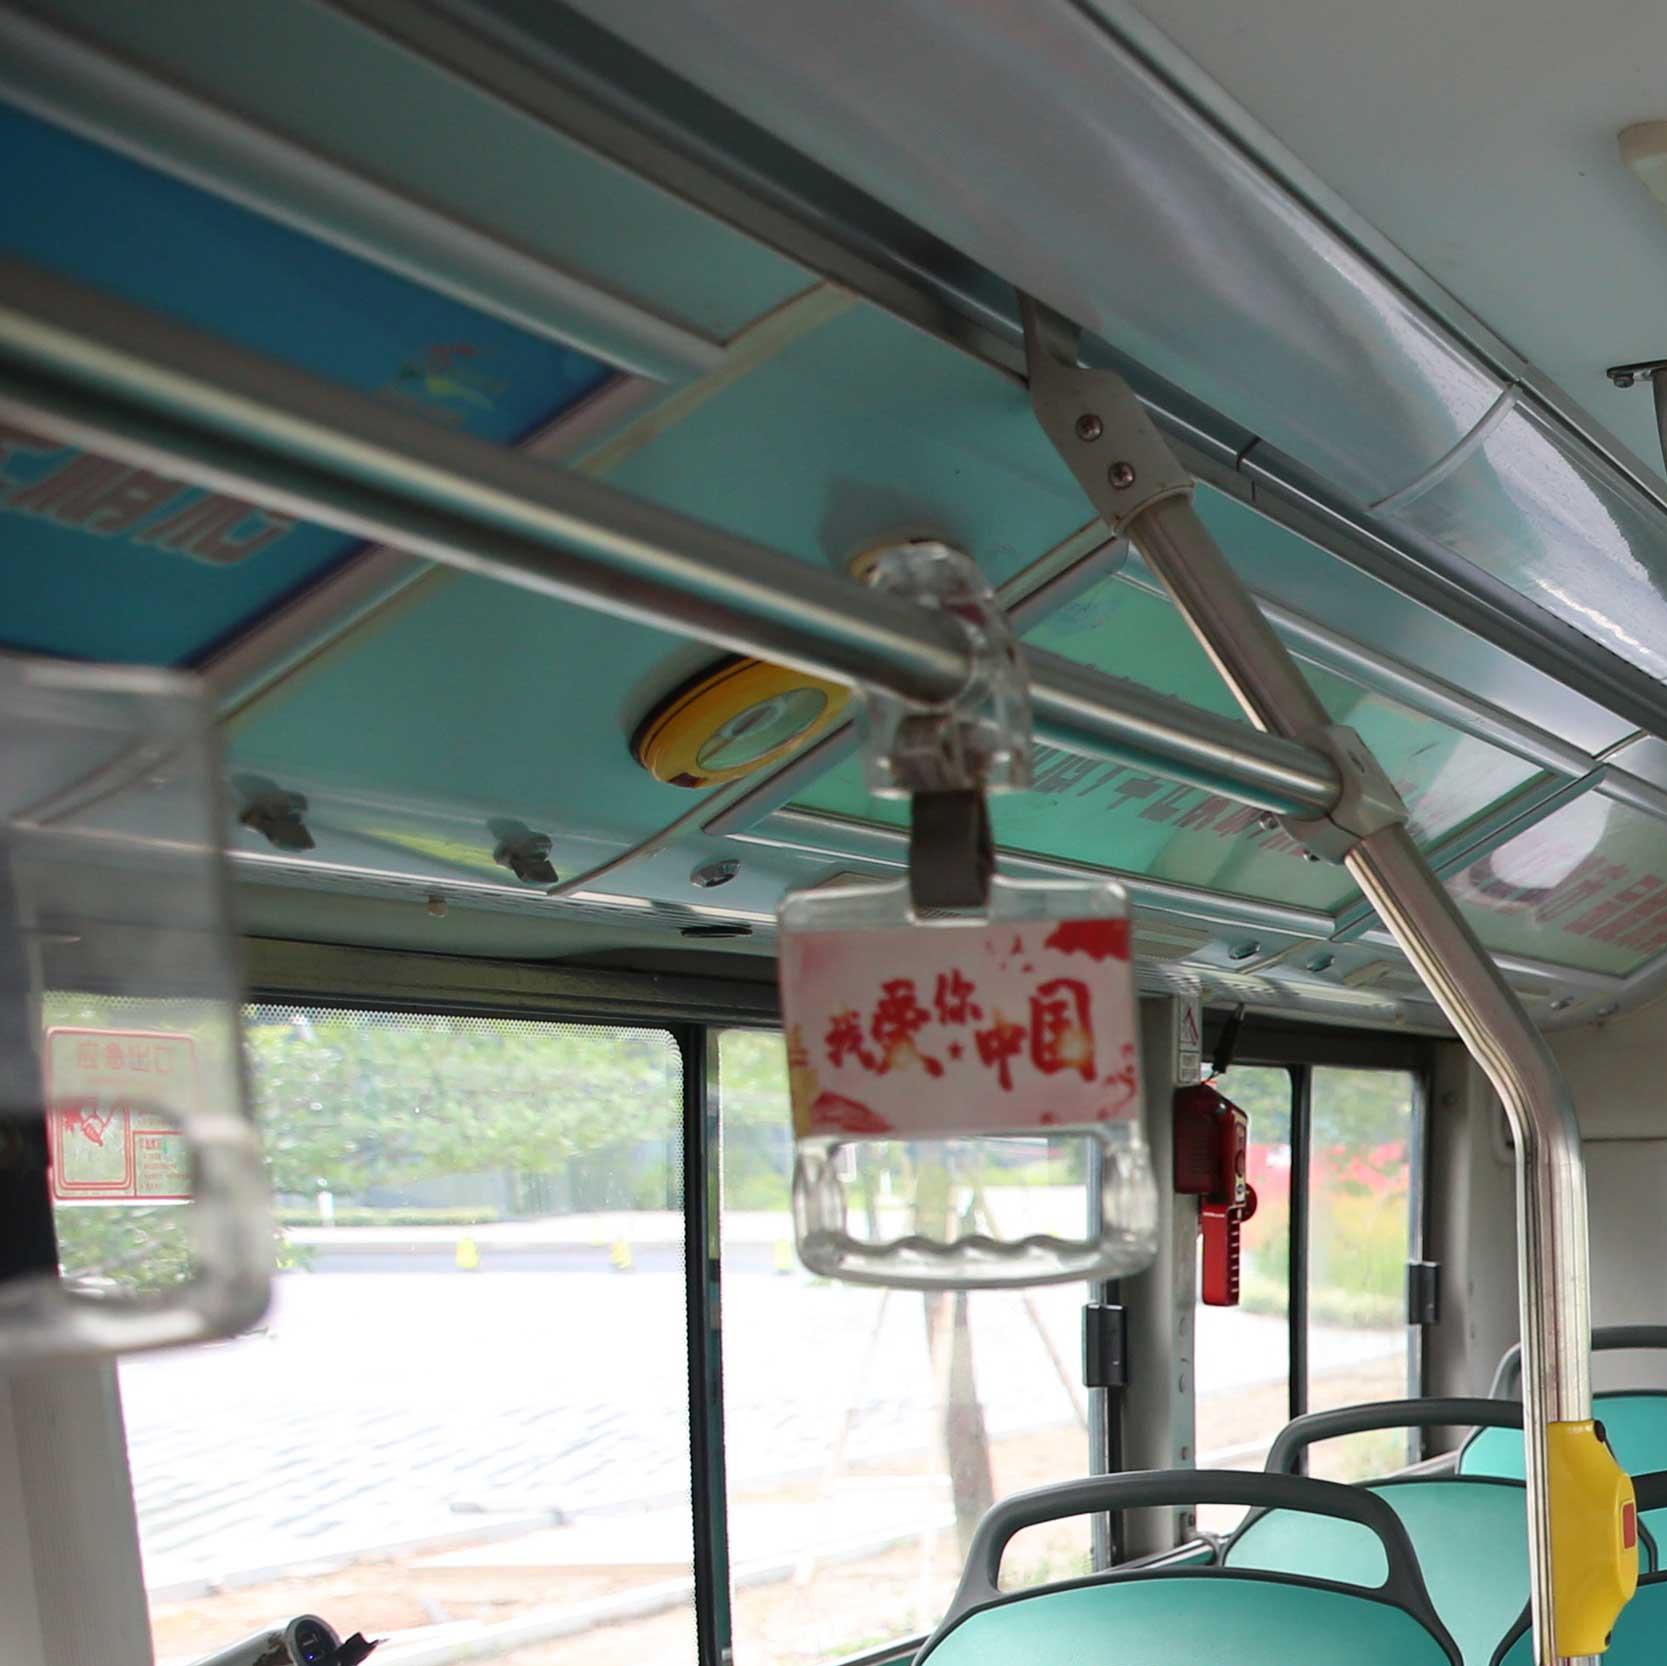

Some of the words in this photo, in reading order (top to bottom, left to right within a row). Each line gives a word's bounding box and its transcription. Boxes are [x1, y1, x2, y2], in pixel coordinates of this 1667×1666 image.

[825, 969, 1097, 1093] 我爱你中国
